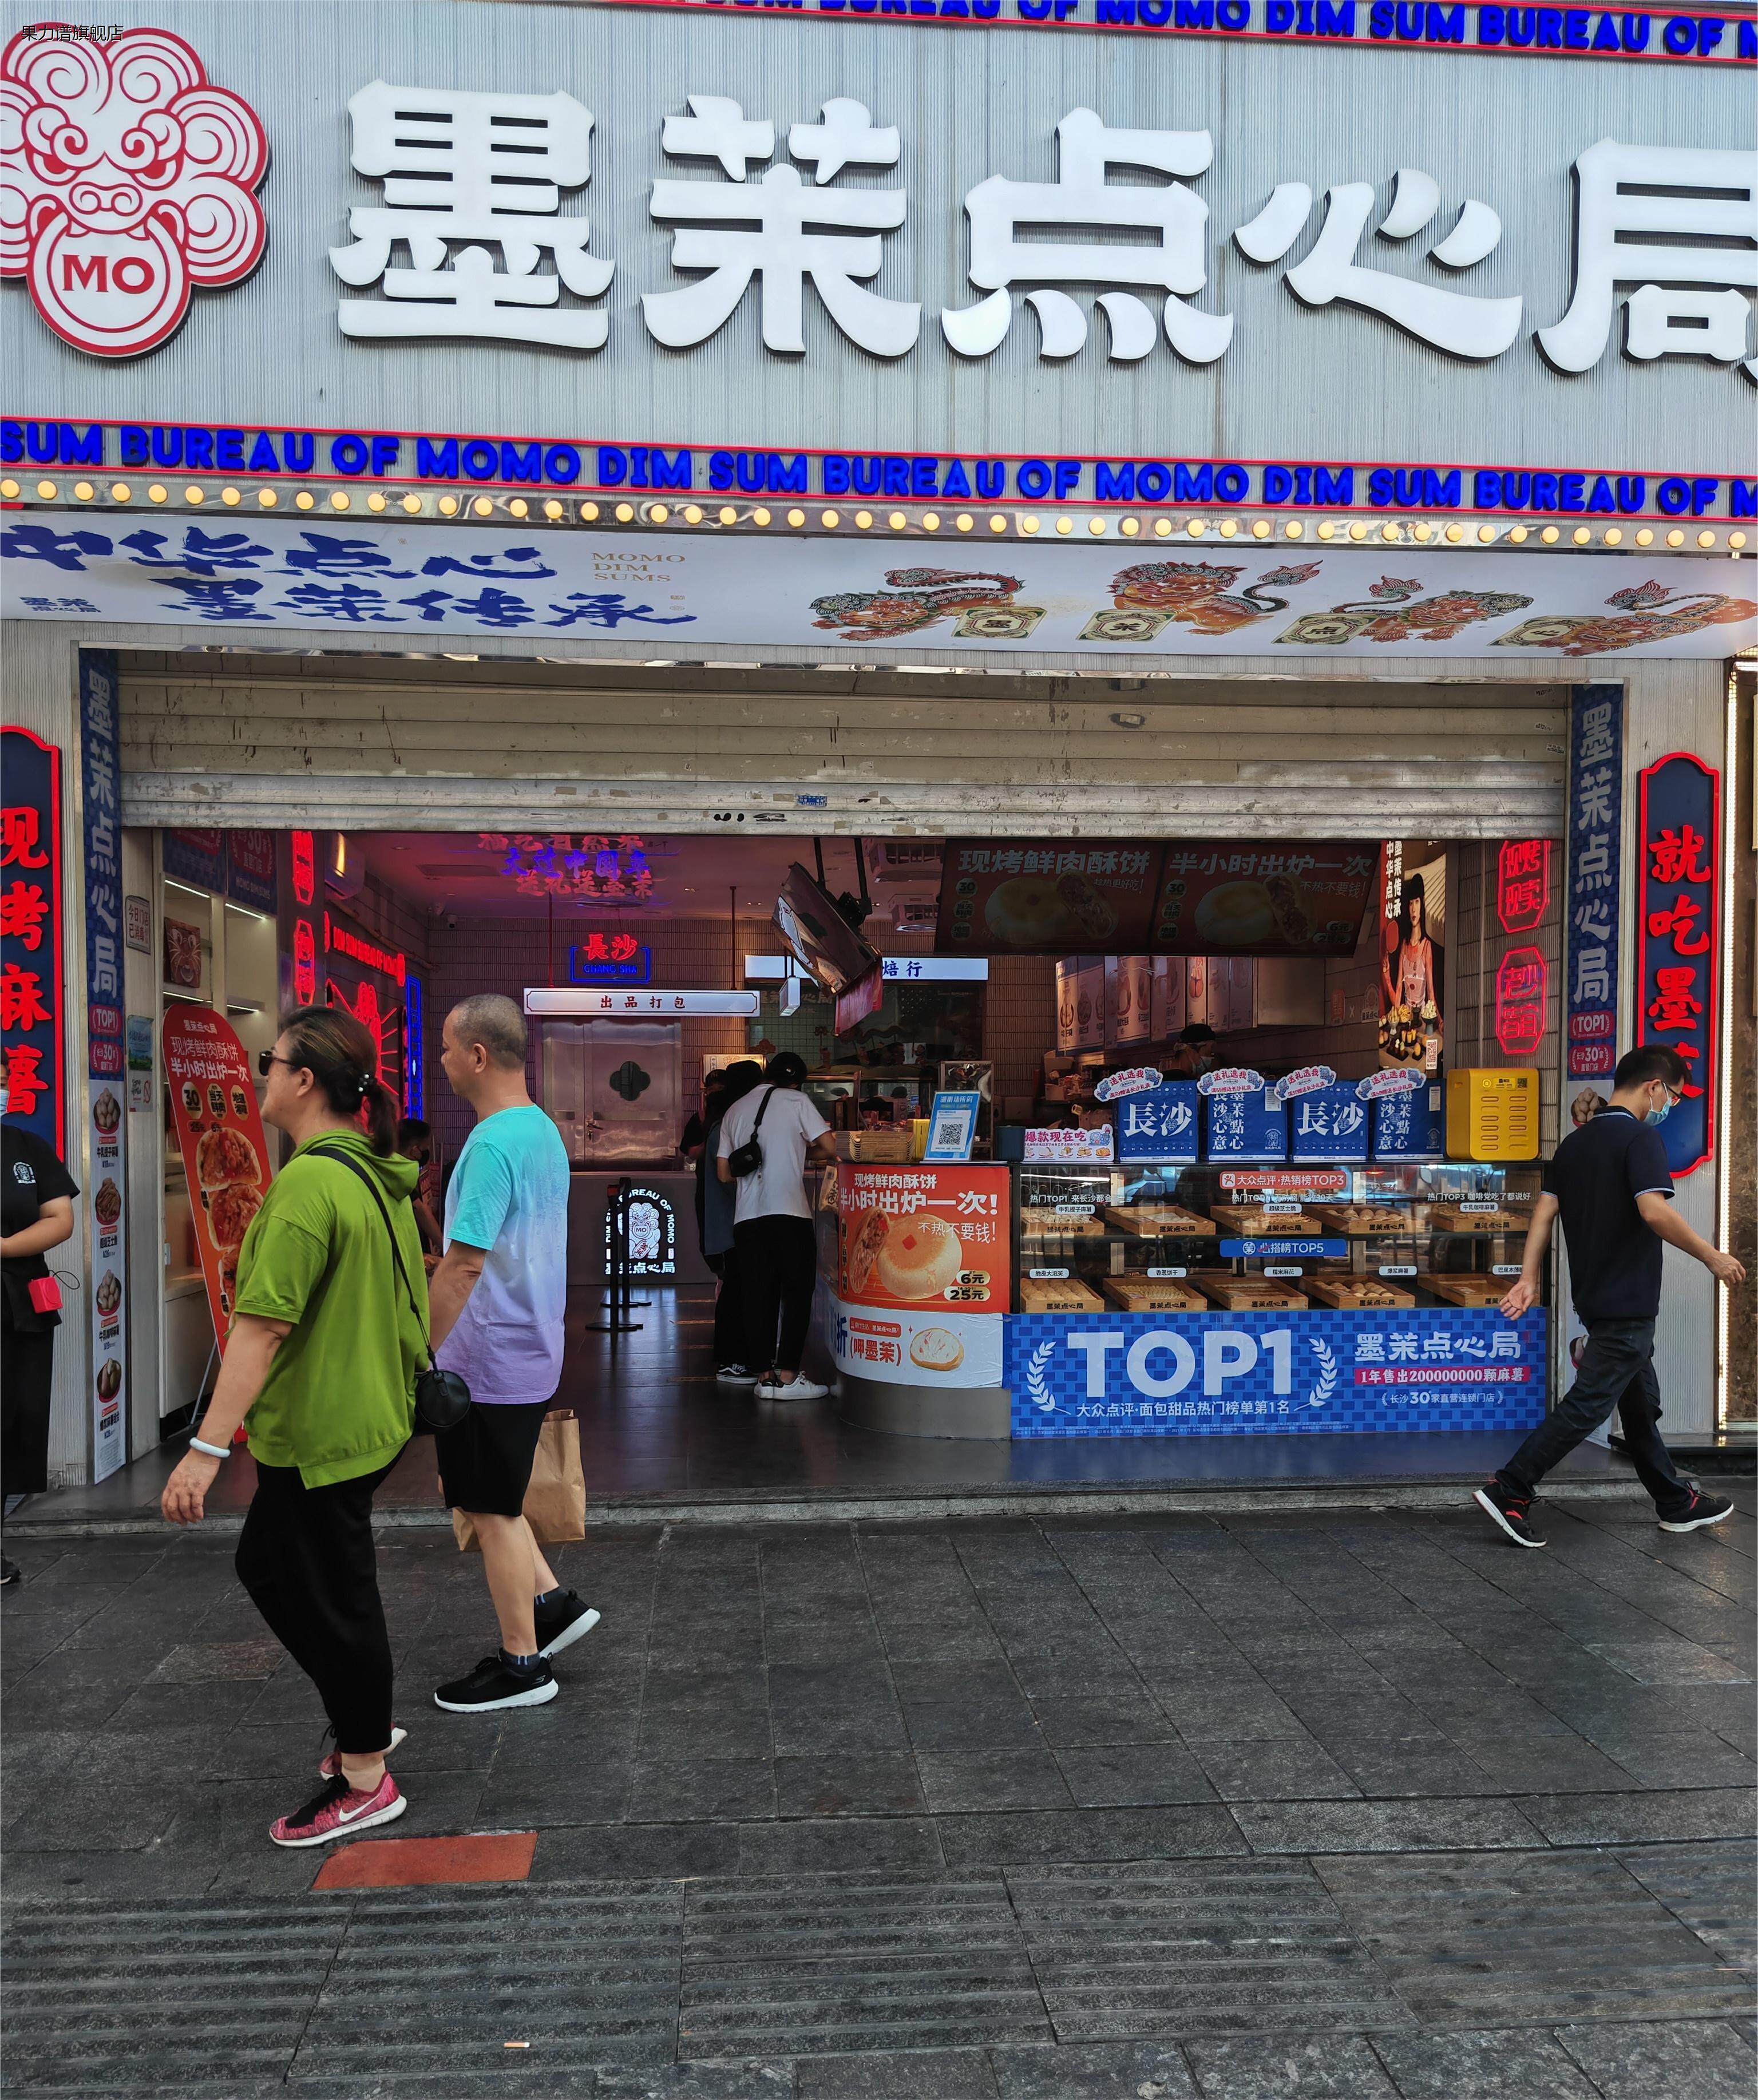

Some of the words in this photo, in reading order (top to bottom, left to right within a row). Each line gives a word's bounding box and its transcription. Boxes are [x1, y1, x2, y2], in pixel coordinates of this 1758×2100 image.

[1265, 0, 1357, 36] DIM
[1371, 2, 1468, 43] SUM
[1479, 5, 1653, 52] BUREAU
[1664, 15, 1727, 56] OF
[328, 79, 1758, 376] 墨茉点心局
[62, 255, 155, 292] MO
[0, 420, 103, 465] SUM
[120, 425, 315, 471] BUREAU
[330, 433, 400, 476] OF
[415, 437, 582, 484] MOMO
[596, 446, 694, 489] DIM
[708, 450, 809, 493] SUM
[821, 455, 1007, 498] BUREAU
[1016, 459, 1083, 500] OF
[1095, 462, 1251, 503] MOMO
[1264, 465, 1355, 505] DIM
[1369, 467, 1463, 508] SUM
[1476, 470, 1647, 513] BUREAU
[1658, 477, 1720, 516] OF
[591, 552, 686, 563] MOMO
[593, 563, 649, 572] DIM
[594, 573, 671, 583] SUMS
[88, 668, 117, 999] 墨茉点心局
[958, 849, 1150, 875] 现烤鲜肉酥饼
[1573, 702, 1614, 1004] 墨茉点心局
[1169, 851, 1372, 877] 半小时出炉一次
[1300, 881, 1368, 898] 不热不要钱!
[1385, 841, 1395, 920] 中华点心
[583, 933, 638, 961] 長沙
[600, 995, 686, 1009] 出品打包
[96, 1008, 115, 1028] TOP1
[183, 1019, 217, 1035] 墨茉点心局
[1577, 1014, 1605, 1032] TOP1
[170, 1036, 239, 1061] 现烤鲜肉酥饼
[171, 1057, 250, 1083] 半小时出炉一次
[1110, 1069, 1144, 1086] 送礼选我
[1212, 1069, 1247, 1081] 送礼选我
[1288, 1068, 1319, 1084] 送礼选我
[1371, 1070, 1407, 1085] 送礼选我
[184, 1089, 200, 1107] 30
[1123, 1101, 1193, 1138] 長沙
[1297, 1101, 1364, 1136] 長沙
[1026, 1131, 1087, 1143] 爆款现在吃
[854, 1173, 937, 1190] 现烤鲜肉酥饼
[1237, 1175, 1344, 1186] 大众点评·热销榜TOP3
[840, 1190, 998, 1216] 半小时出炉一次!
[1030, 1194, 1068, 1203] 热门TOP1
[1427, 1192, 1466, 1201] 热门TOP3
[1467, 1191, 1531, 1201] 咖啡党吃了都说好
[666, 1214, 675, 1243] MOMO
[917, 1221, 996, 1244] 不热不要钱!
[960, 1274, 985, 1284] 6元
[949, 1289, 984, 1301] 25元
[1355, 1331, 1522, 1362] 墨茉点心局
[1067, 1329, 1292, 1398] TOP1
[1076, 1400, 1290, 1418] 大众点评·面包甜品热门榜单第1名
